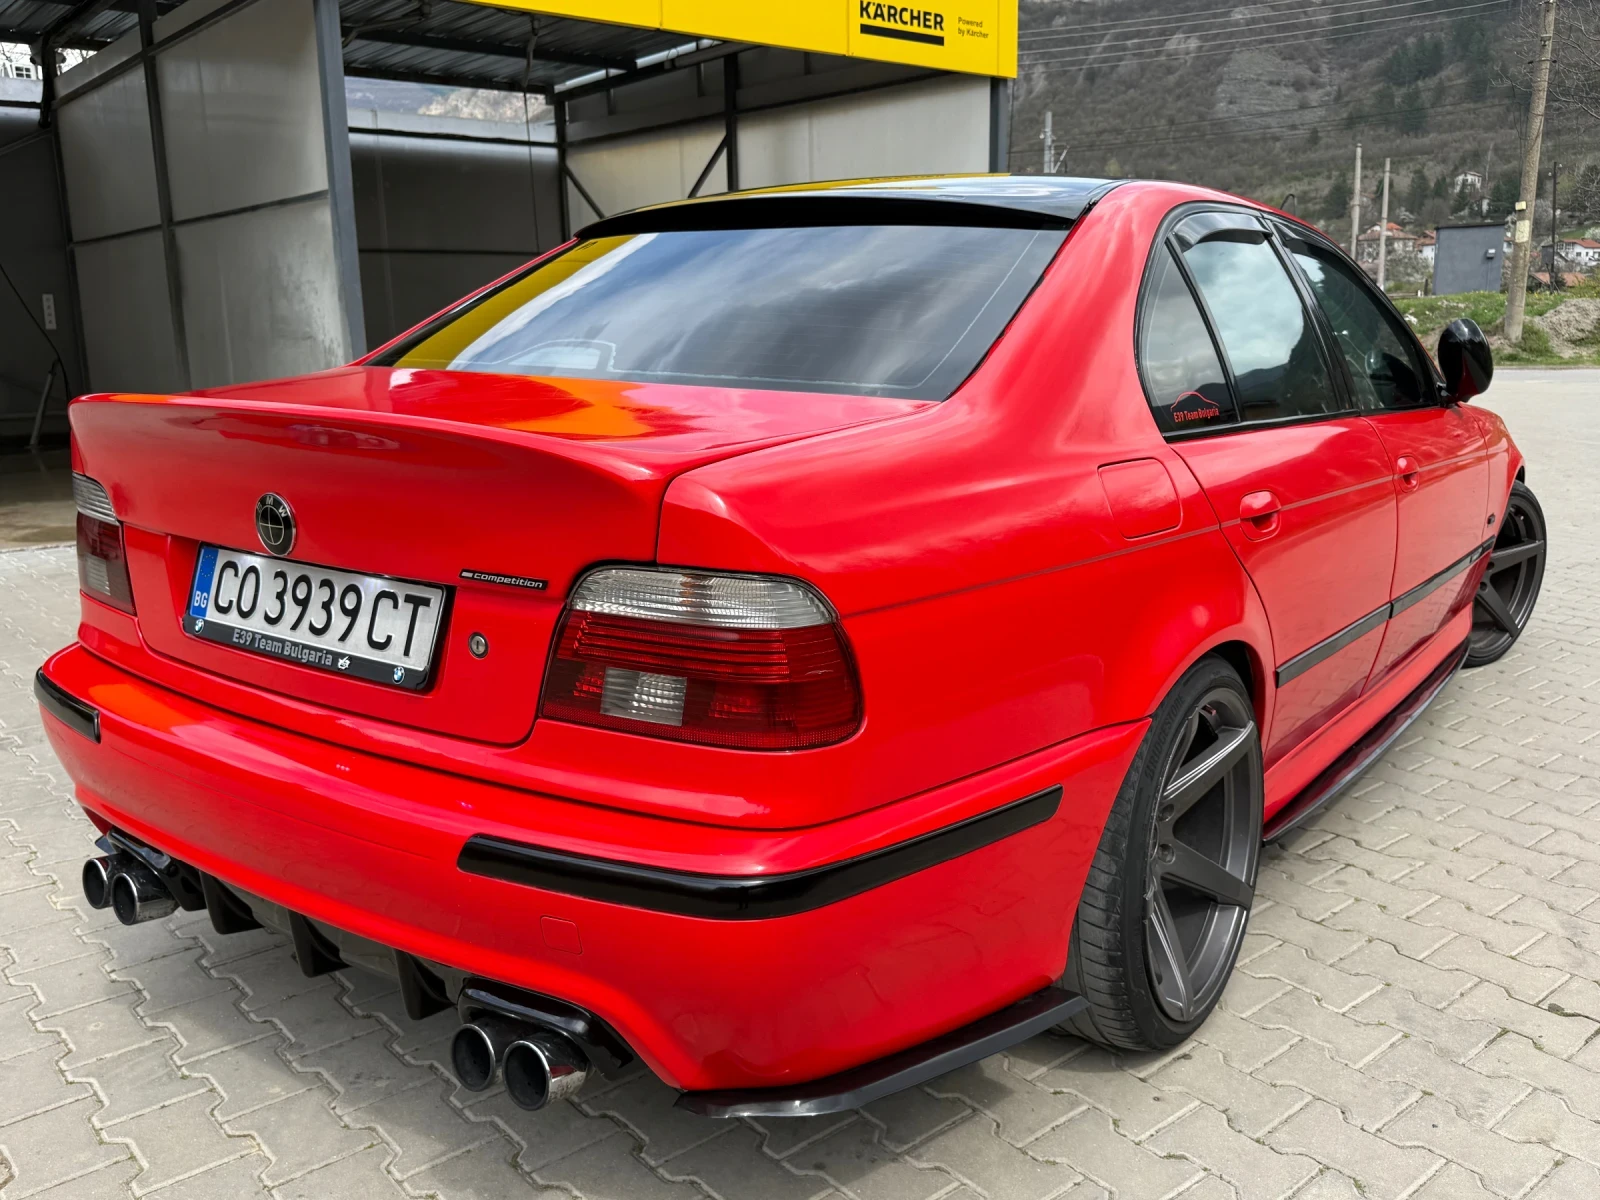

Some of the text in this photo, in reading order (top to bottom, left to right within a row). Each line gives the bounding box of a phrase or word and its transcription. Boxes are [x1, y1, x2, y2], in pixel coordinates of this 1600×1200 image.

[860, 0, 944, 31] KÄRCHER
[958, 17, 983, 28] Powered
[958, 28, 965, 37] by
[1173, 412, 1184, 423] E39
[1185, 411, 1199, 420] Team
[474, 572, 543, 588] competition
[193, 590, 208, 609] BG
[263, 569, 363, 642] 3939
[366, 589, 432, 657] CT
[232, 628, 333, 667] E39 Team Bulgaria
